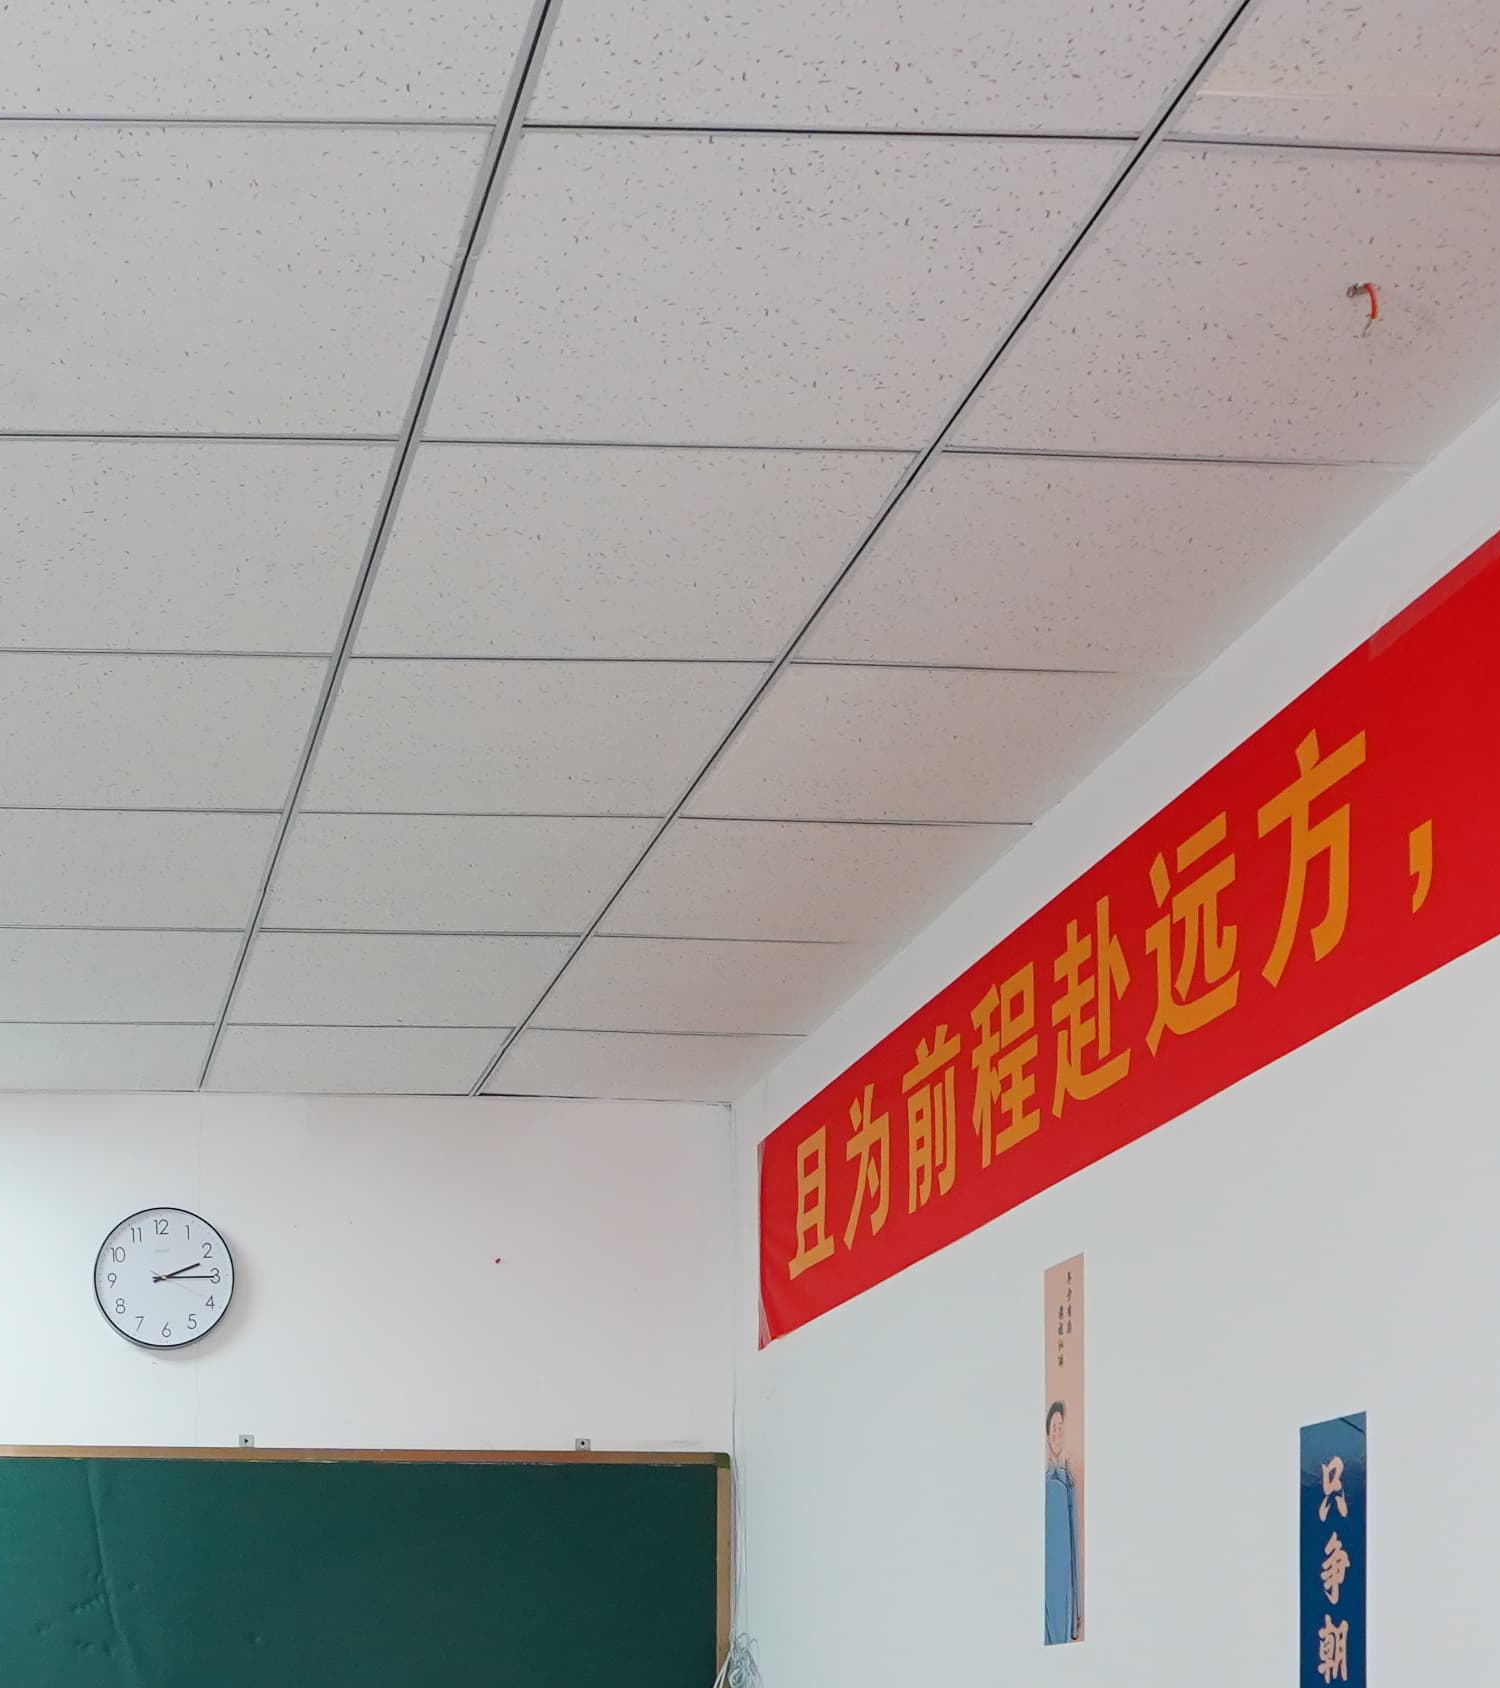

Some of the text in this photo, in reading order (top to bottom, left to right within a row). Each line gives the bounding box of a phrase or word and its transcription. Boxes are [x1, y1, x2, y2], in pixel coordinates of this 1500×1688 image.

[130, 1227, 142, 1243] 11
[154, 1219, 169, 1235] 12
[185, 1225, 190, 1240] 1
[111, 1246, 126, 1263] 10
[202, 1243, 213, 1258] 2
[107, 1273, 117, 1288] 9
[210, 1267, 221, 1284] 3
[115, 1298, 126, 1314] 8
[205, 1295, 215, 1310] 4
[135, 1316, 145, 1332] 7
[187, 1313, 198, 1329] 5
[161, 1322, 172, 1338] 6
